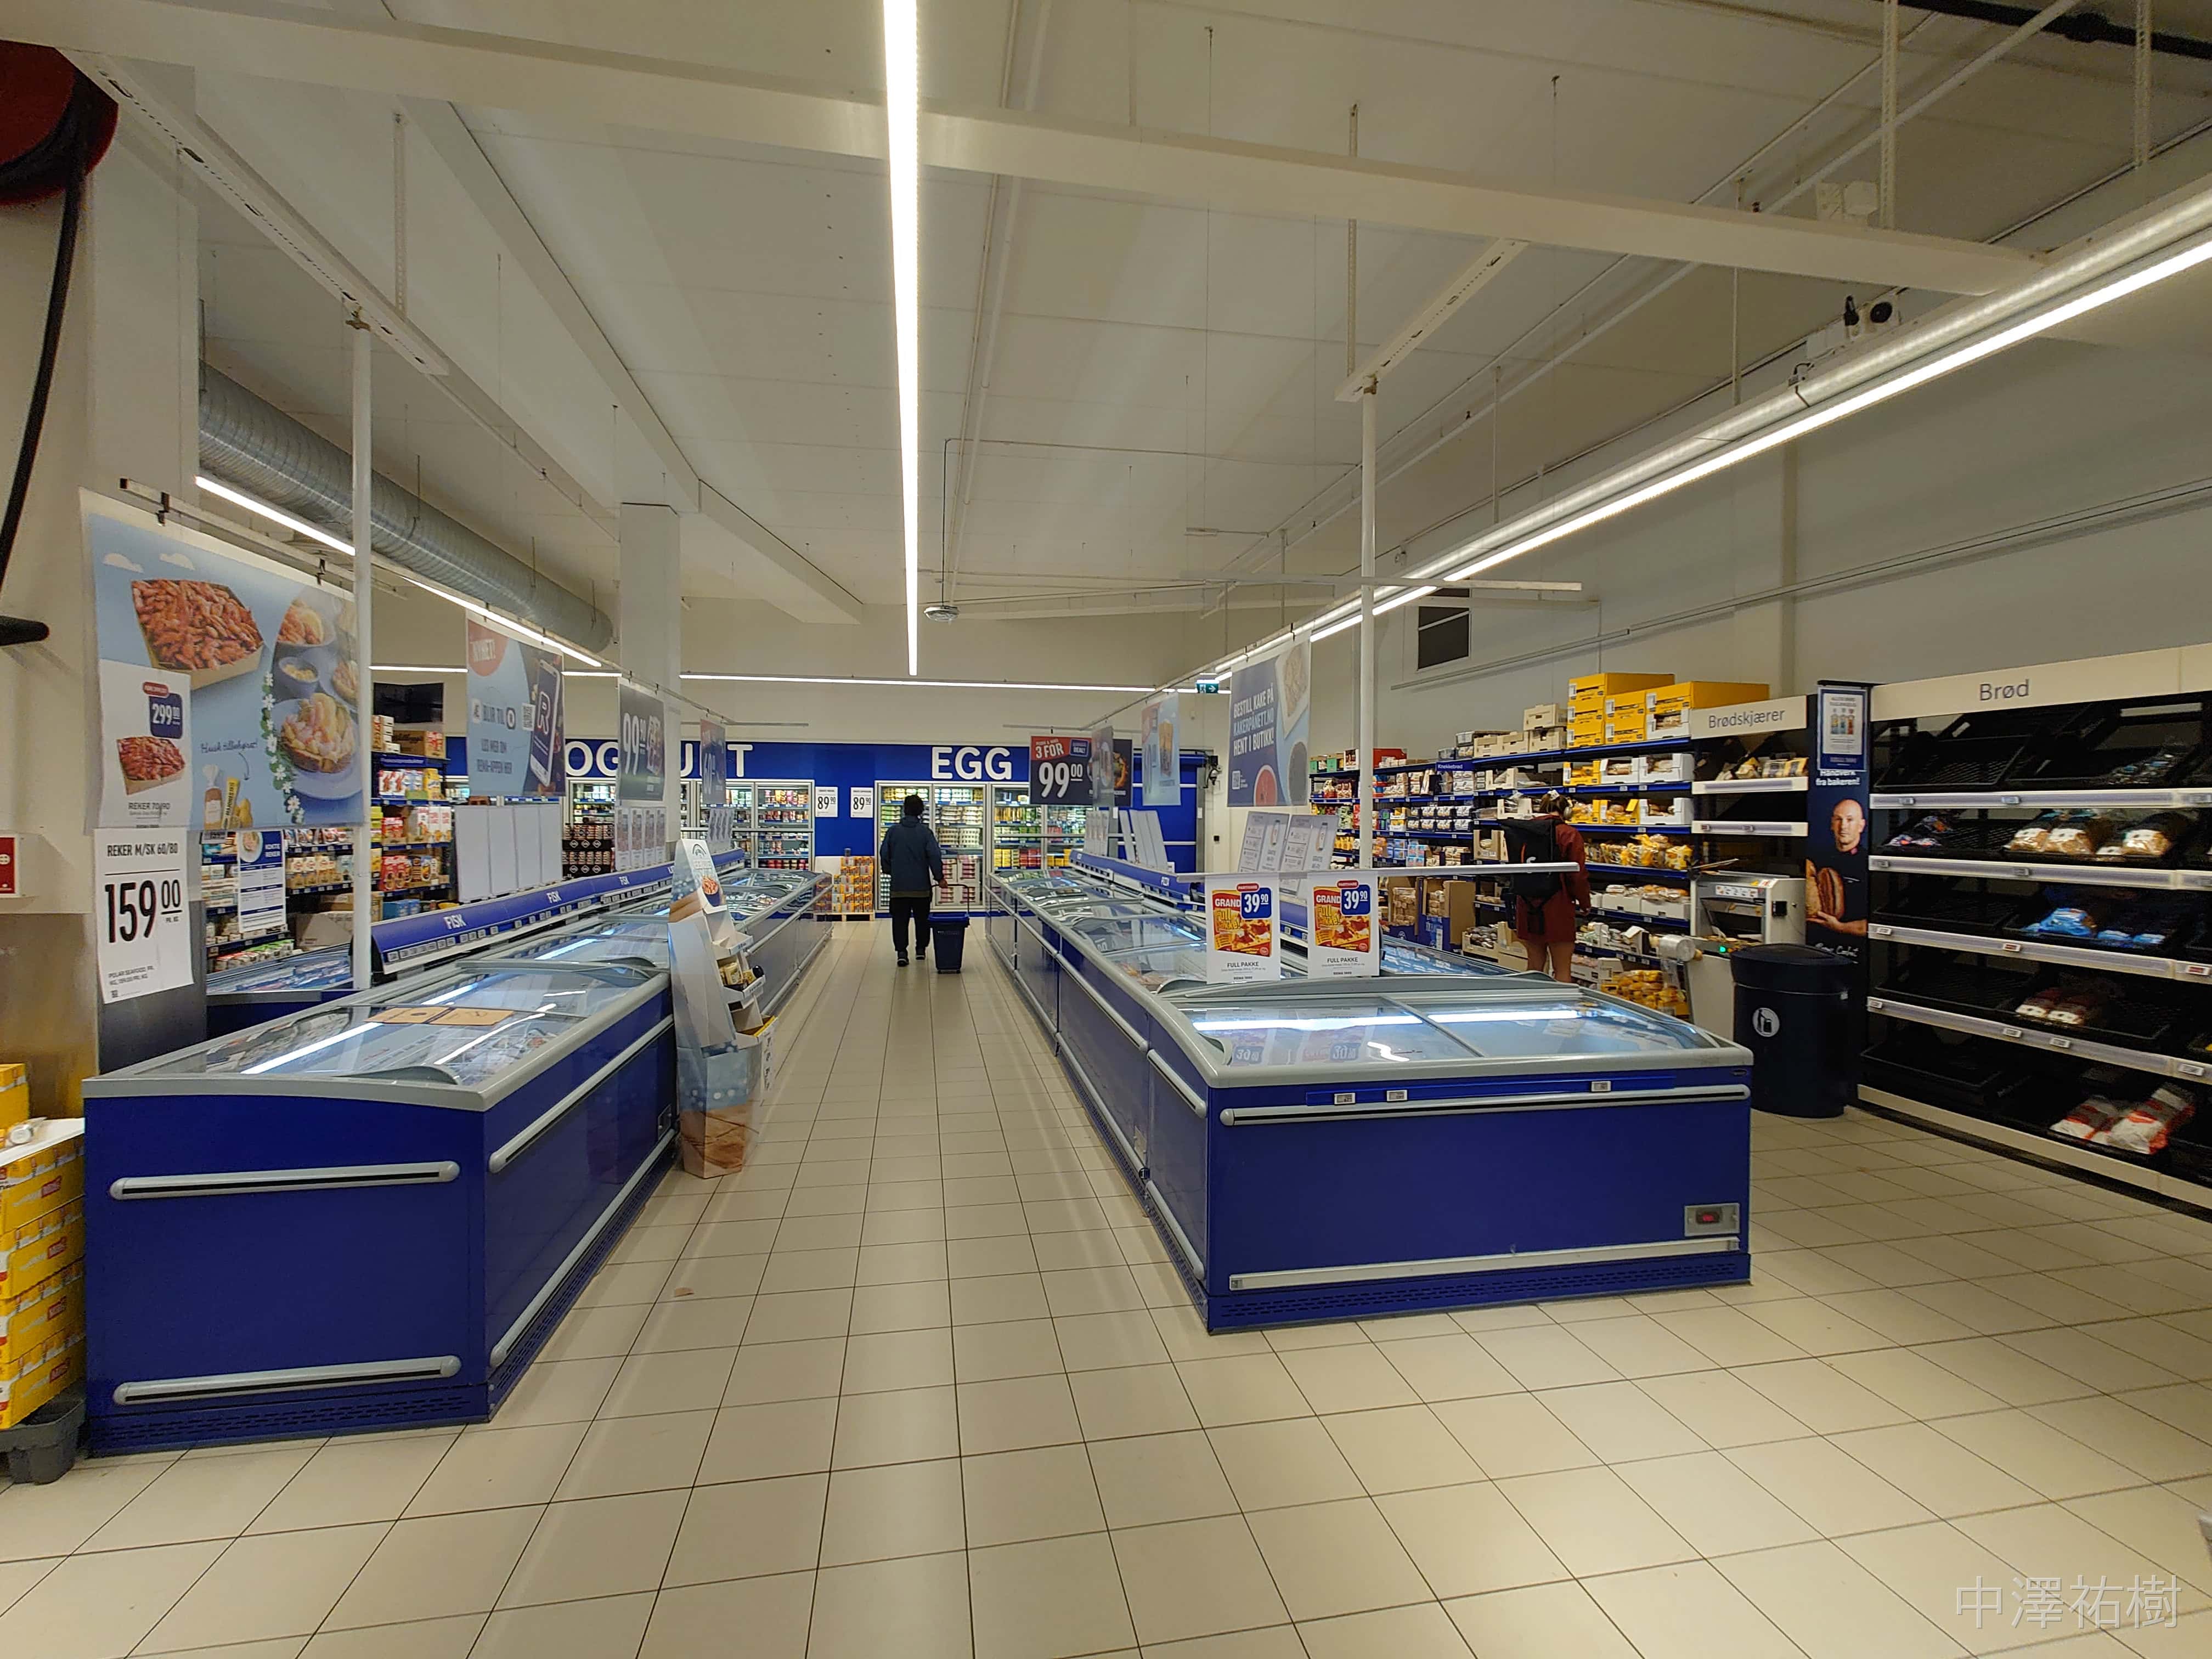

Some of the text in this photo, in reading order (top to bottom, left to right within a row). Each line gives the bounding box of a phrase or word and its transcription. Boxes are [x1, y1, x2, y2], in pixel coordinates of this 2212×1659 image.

[1980, 679, 2029, 701] Brød
[1234, 682, 1274, 718] BESTILL KAKE PÅ
[152, 703, 172, 725] 299
[1709, 710, 1785, 728] Brødskjærer
[623, 713, 640, 776] 99
[1036, 743, 1064, 758] 3 FOR
[1234, 736, 1247, 756] HENT
[932, 747, 1012, 780] EGG
[1039, 762, 1084, 798] 99 00
[817, 796, 830, 810] 89
[853, 797, 865, 810] 89
[107, 845, 132, 856] REKER
[134, 843, 156, 856] M/SK
[546, 891, 562, 904] FISK
[1215, 899, 1240, 907] GRAND
[1244, 894, 1268, 913] 39 90
[1316, 895, 1340, 904] GRAND
[1344, 890, 1368, 910] 39 90
[104, 879, 182, 943] 159 00
[443, 913, 467, 929] FISK
